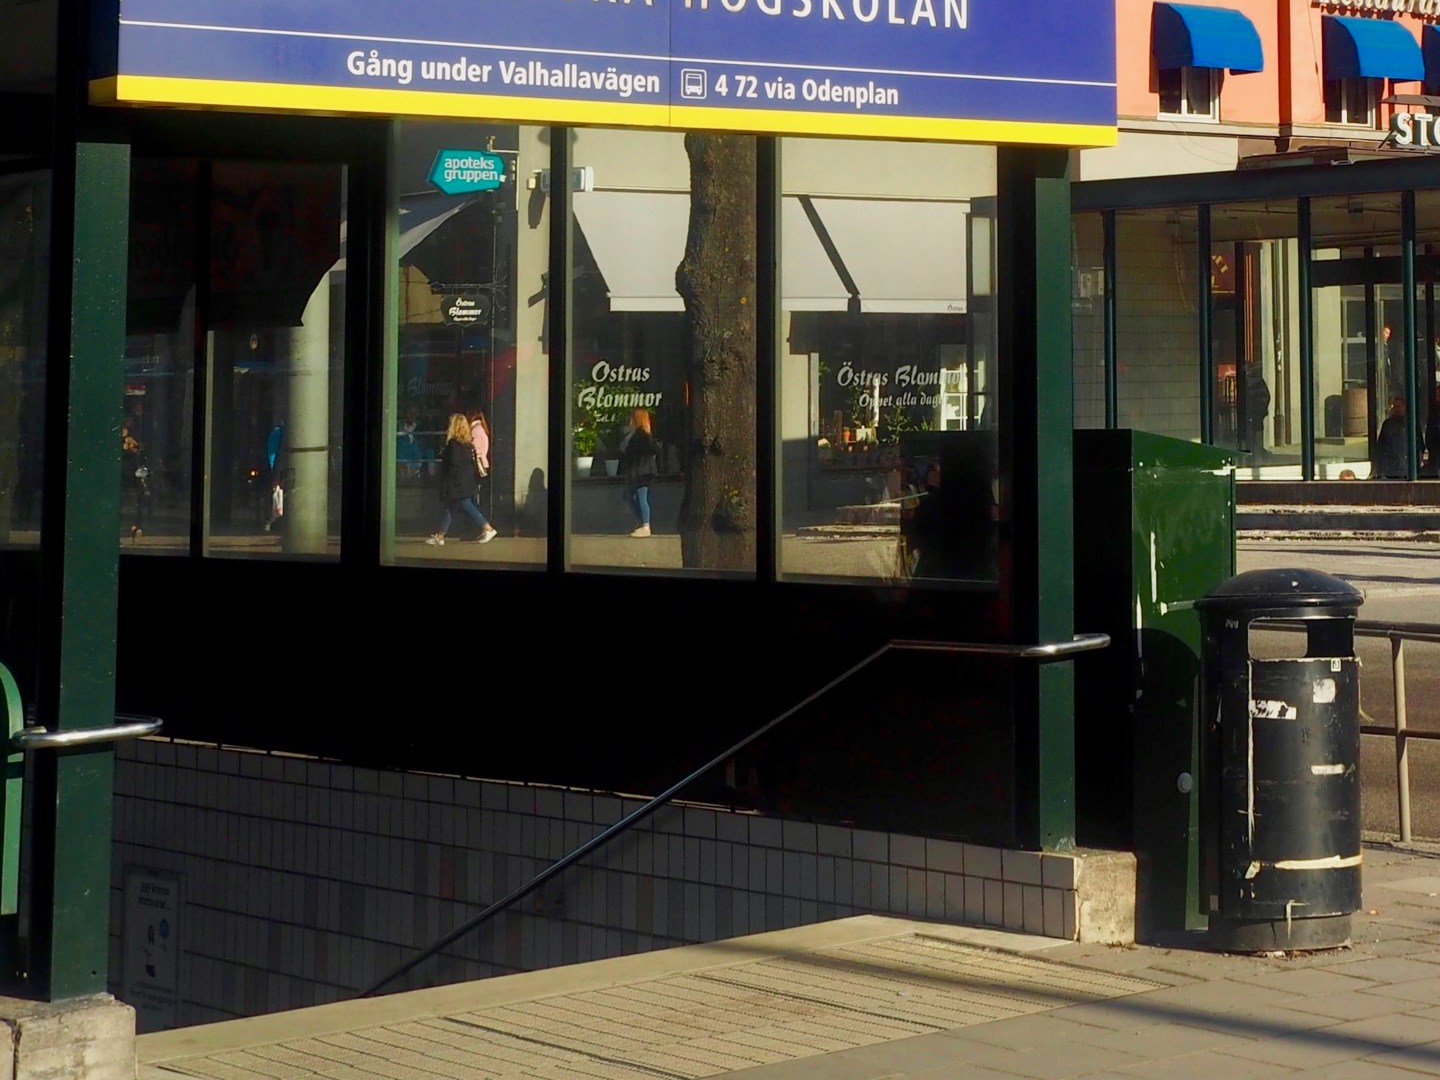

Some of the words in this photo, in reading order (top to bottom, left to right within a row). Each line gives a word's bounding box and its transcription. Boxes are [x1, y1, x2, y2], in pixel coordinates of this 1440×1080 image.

[346, 50, 413, 85] Gång
[421, 55, 491, 85] under
[499, 59, 659, 99] Valhallavägen
[714, 73, 728, 96] 4
[735, 75, 758, 98] 72
[764, 79, 796, 101] via
[802, 78, 899, 110] Odenplan
[444, 156, 495, 170] apoteks
[444, 169, 498, 182] gruppen
[837, 361, 889, 387] Östras
[578, 386, 662, 410] Blommor
[896, 392, 917, 406] alla
